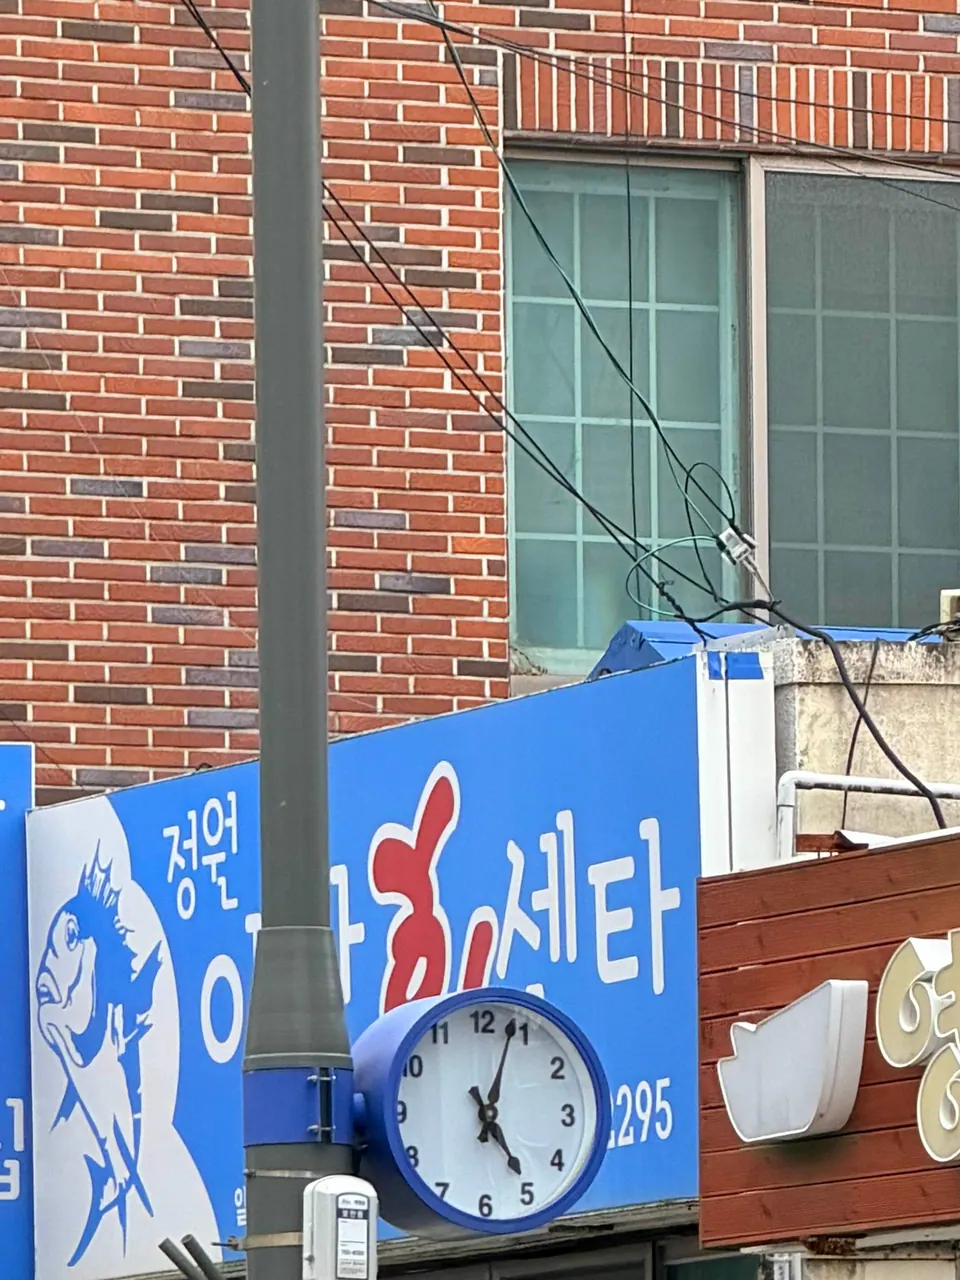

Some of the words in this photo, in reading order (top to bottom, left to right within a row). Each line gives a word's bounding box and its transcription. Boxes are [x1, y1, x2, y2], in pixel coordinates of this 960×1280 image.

[430, 1021, 449, 1044] 11
[469, 1010, 496, 1034] 12
[518, 1022, 529, 1045] 1
[550, 1056, 565, 1080] 2
[560, 1104, 575, 1127] 3
[607, 1077, 673, 1149] 295
[550, 1149, 564, 1172] 4
[520, 1182, 534, 1205] 5
[478, 1194, 492, 1217] 6
